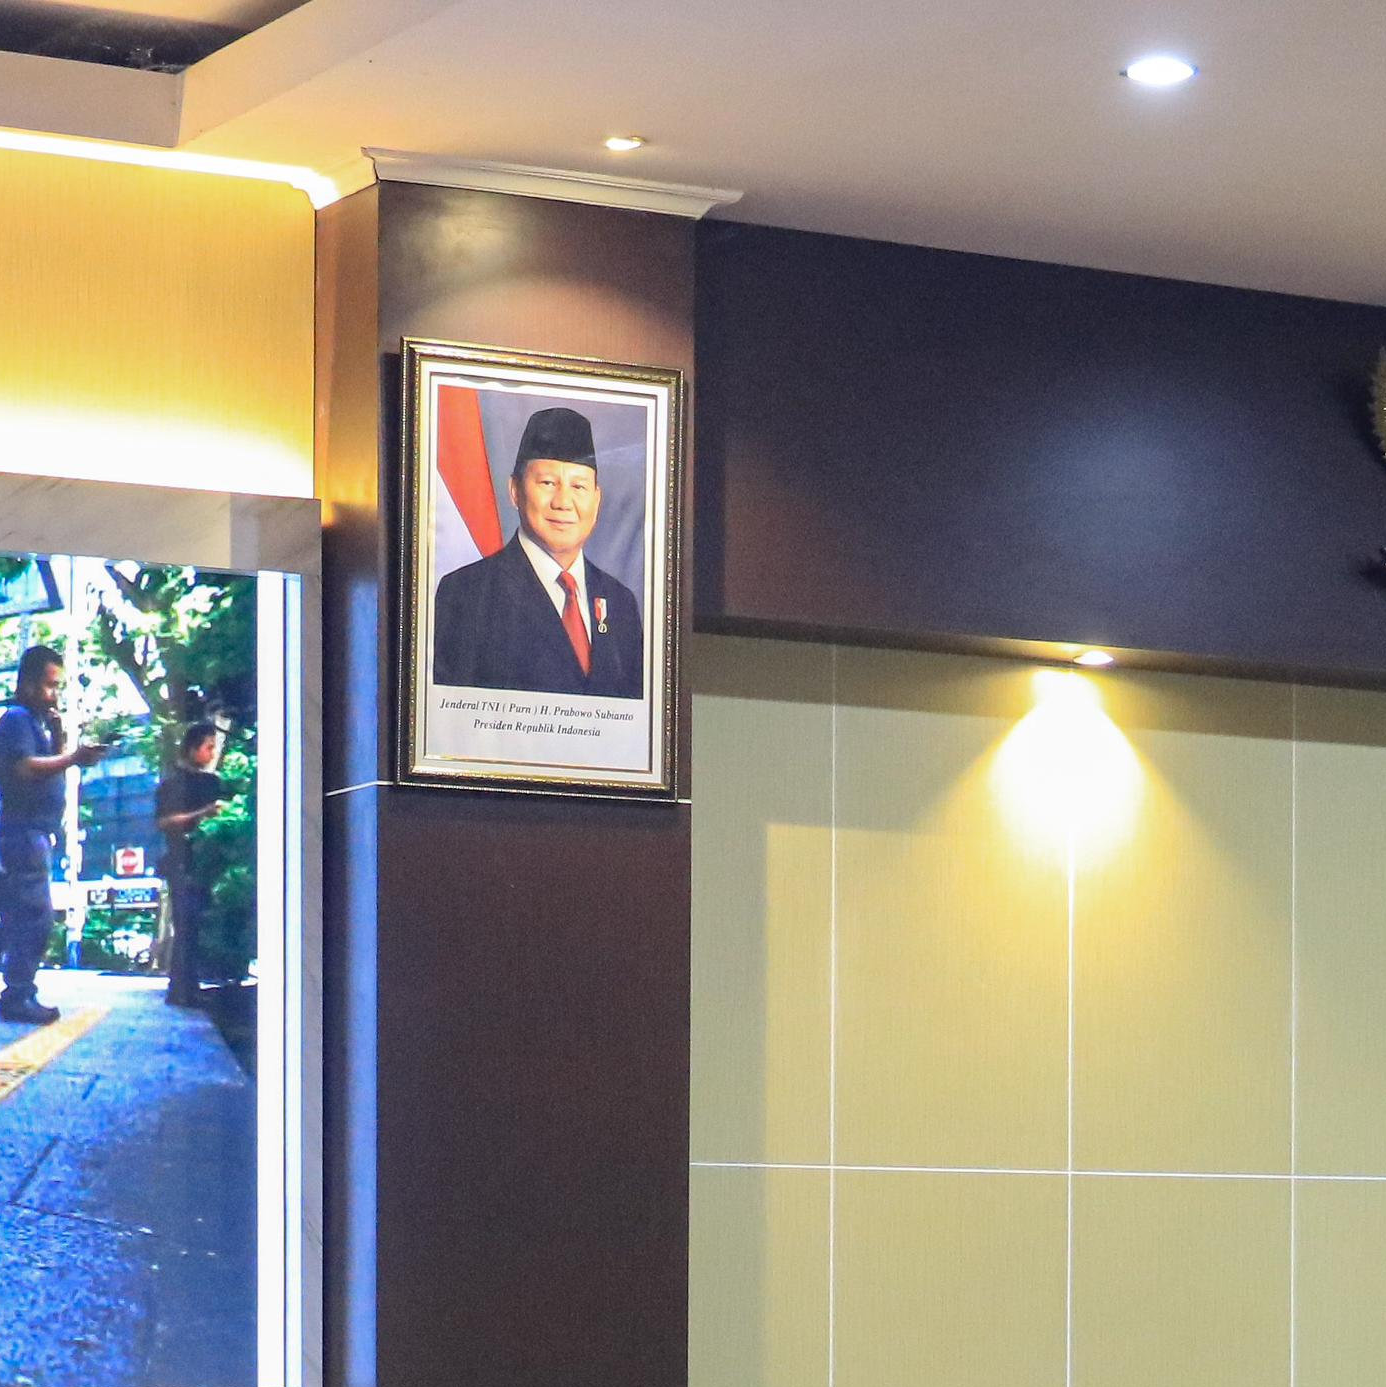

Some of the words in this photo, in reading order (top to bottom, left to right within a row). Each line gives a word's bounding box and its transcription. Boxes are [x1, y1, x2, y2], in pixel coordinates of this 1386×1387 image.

[439, 698, 480, 711] Jenderal
[481, 701, 500, 712] TNI
[554, 706, 593, 718] Prabowo
[595, 708, 634, 721] Subianto
[473, 718, 513, 731] Presiden
[515, 721, 555, 734] Republik
[557, 724, 601, 737] Indonesia
